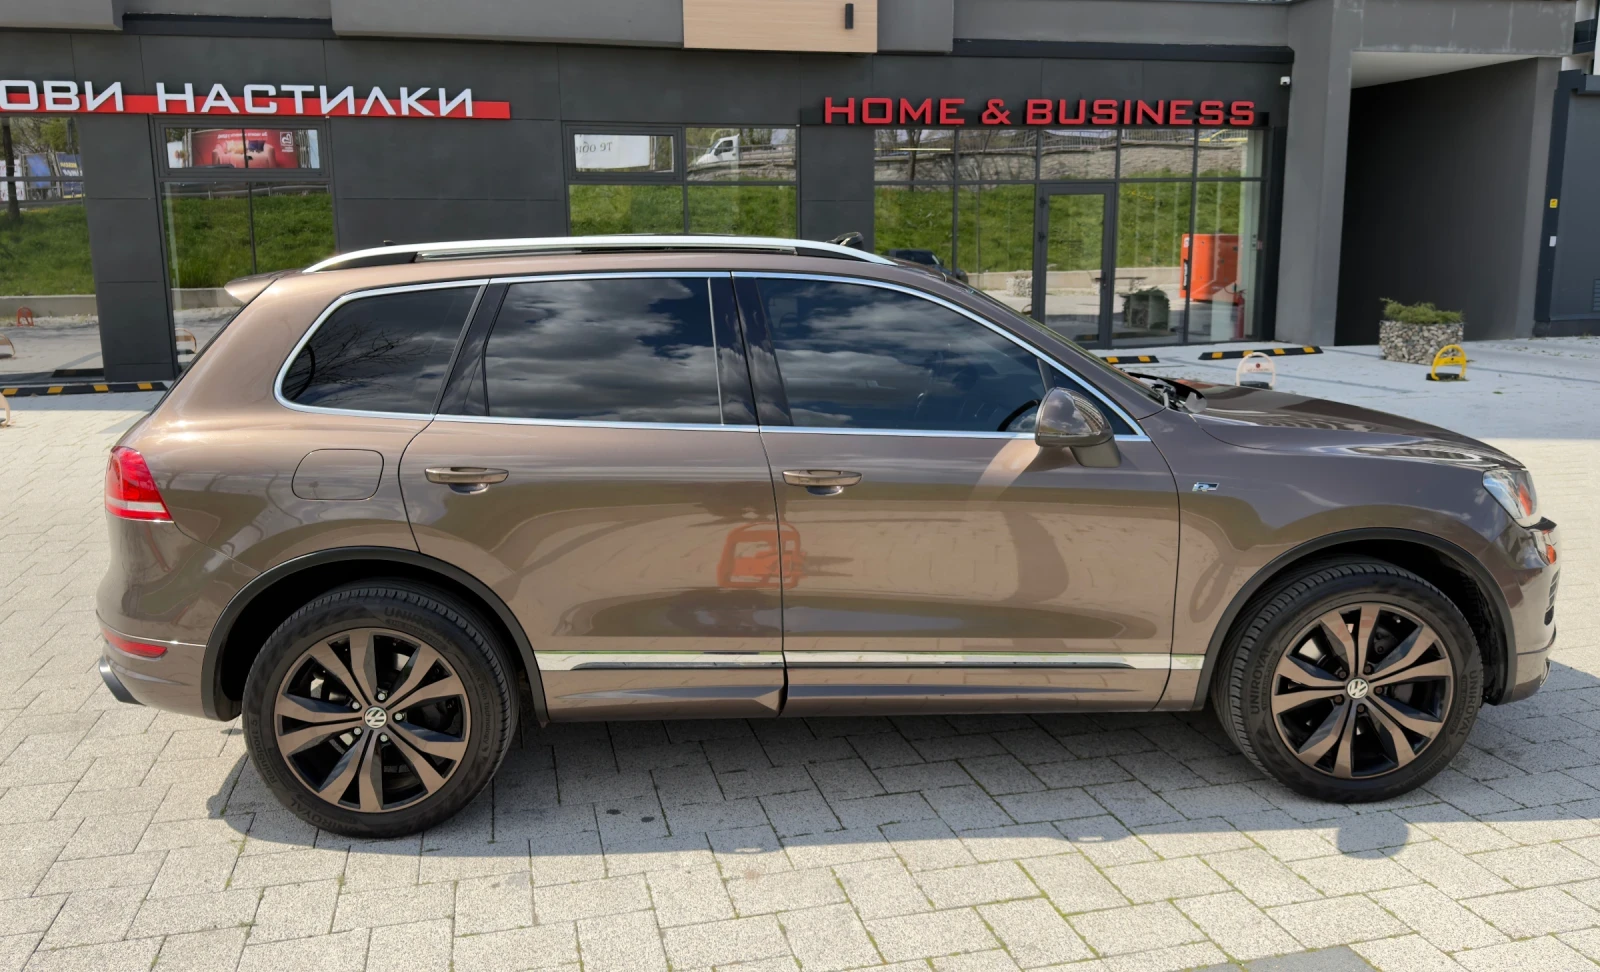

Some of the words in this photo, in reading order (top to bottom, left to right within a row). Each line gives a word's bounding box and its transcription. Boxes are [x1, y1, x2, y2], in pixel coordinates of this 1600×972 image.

[0, 79, 124, 112] ОВИ
[155, 81, 474, 117] НАСТИЛКИ
[824, 97, 965, 125] HOME
[981, 99, 1012, 126] &
[1026, 98, 1256, 126] BUSINESS
[1250, 646, 1274, 715] UNIROYAL
[1455, 669, 1478, 738] UNIROYAL
